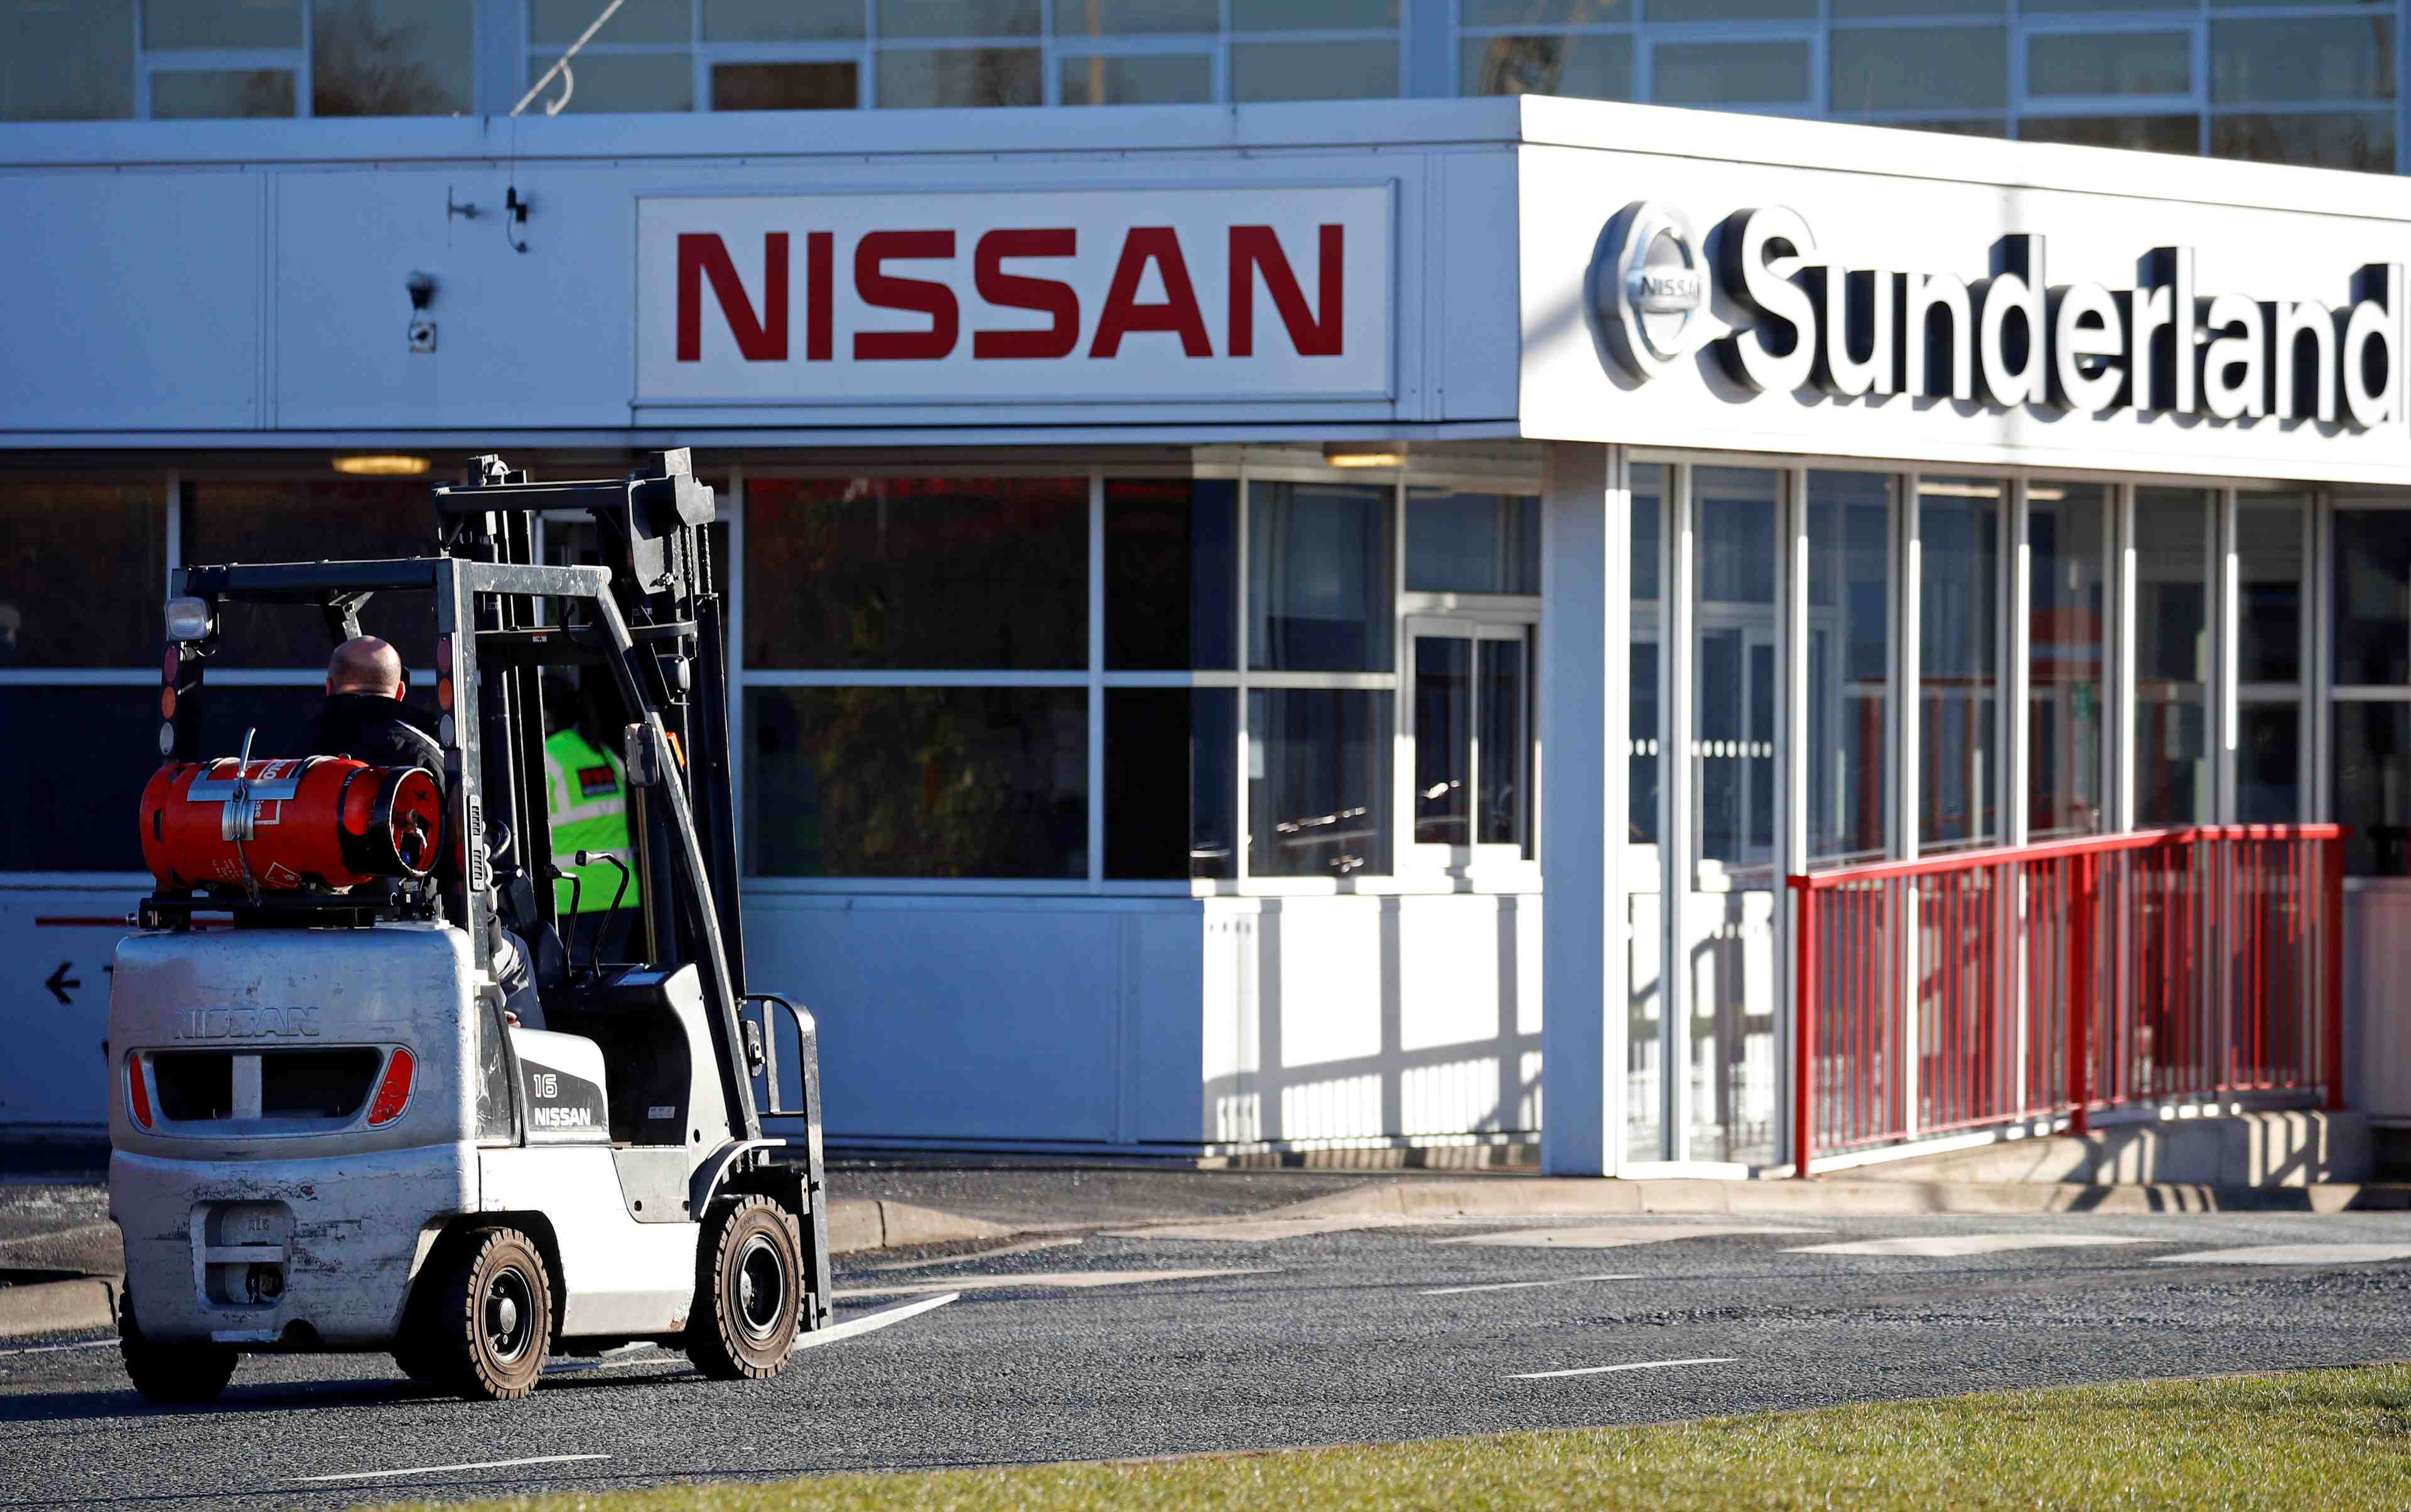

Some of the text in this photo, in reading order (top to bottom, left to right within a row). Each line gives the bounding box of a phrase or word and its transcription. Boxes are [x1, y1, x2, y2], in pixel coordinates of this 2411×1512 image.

[676, 224, 1344, 362] NISSAN
[1640, 276, 1700, 297] NISSA
[1703, 204, 2404, 432] Sunderland
[534, 1074, 558, 1098] 16
[534, 1107, 591, 1126] NISSAN
